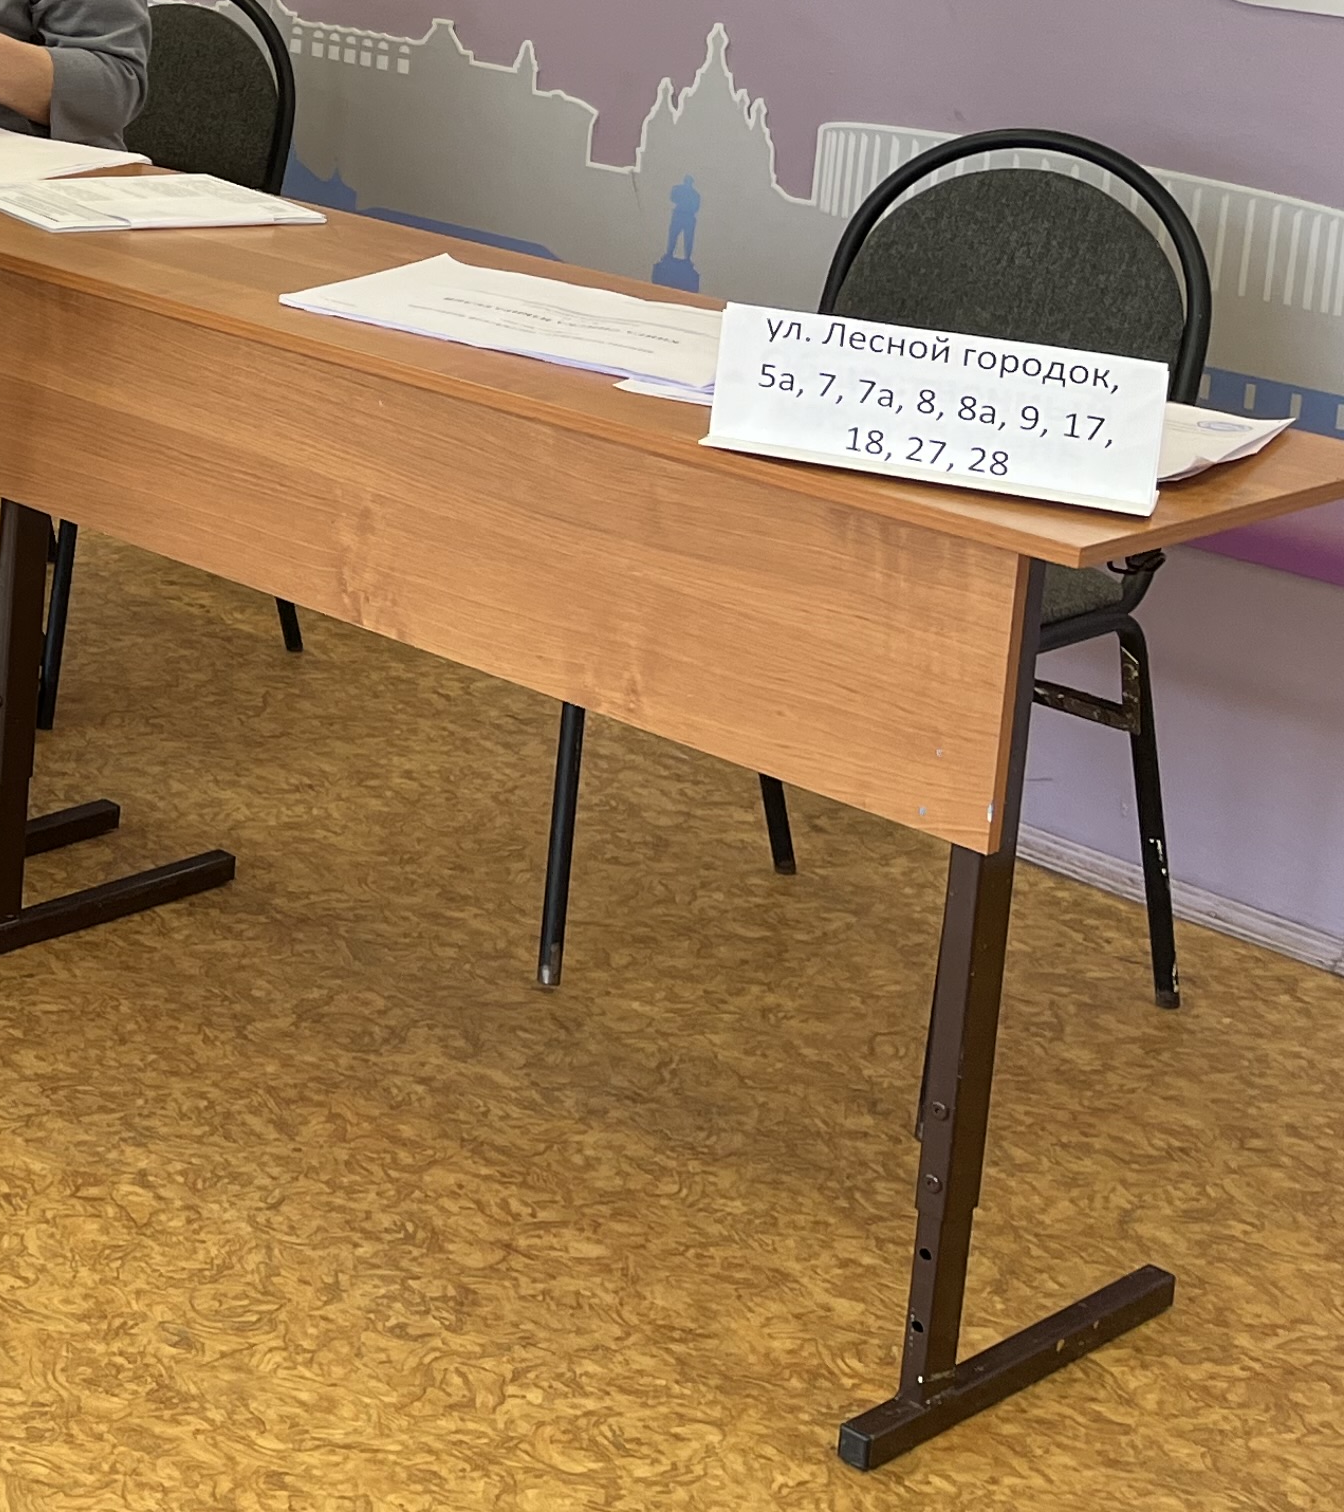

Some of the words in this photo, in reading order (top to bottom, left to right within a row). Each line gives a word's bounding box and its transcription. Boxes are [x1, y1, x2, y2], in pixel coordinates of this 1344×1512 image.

[766, 317, 811, 343] ул.
[822, 322, 951, 364] Лесной
[962, 346, 1119, 394] городок,
[758, 363, 804, 398] 5а,
[819, 372, 844, 405] 7,
[858, 379, 904, 414] 7а,
[916, 389, 945, 422] 8,
[957, 395, 1006, 432] 8а,
[1019, 405, 1048, 439] 9,
[1064, 413, 1114, 449] 17,
[846, 426, 893, 462] 18,
[905, 435, 955, 472] 27,
[968, 446, 1010, 477] 28
